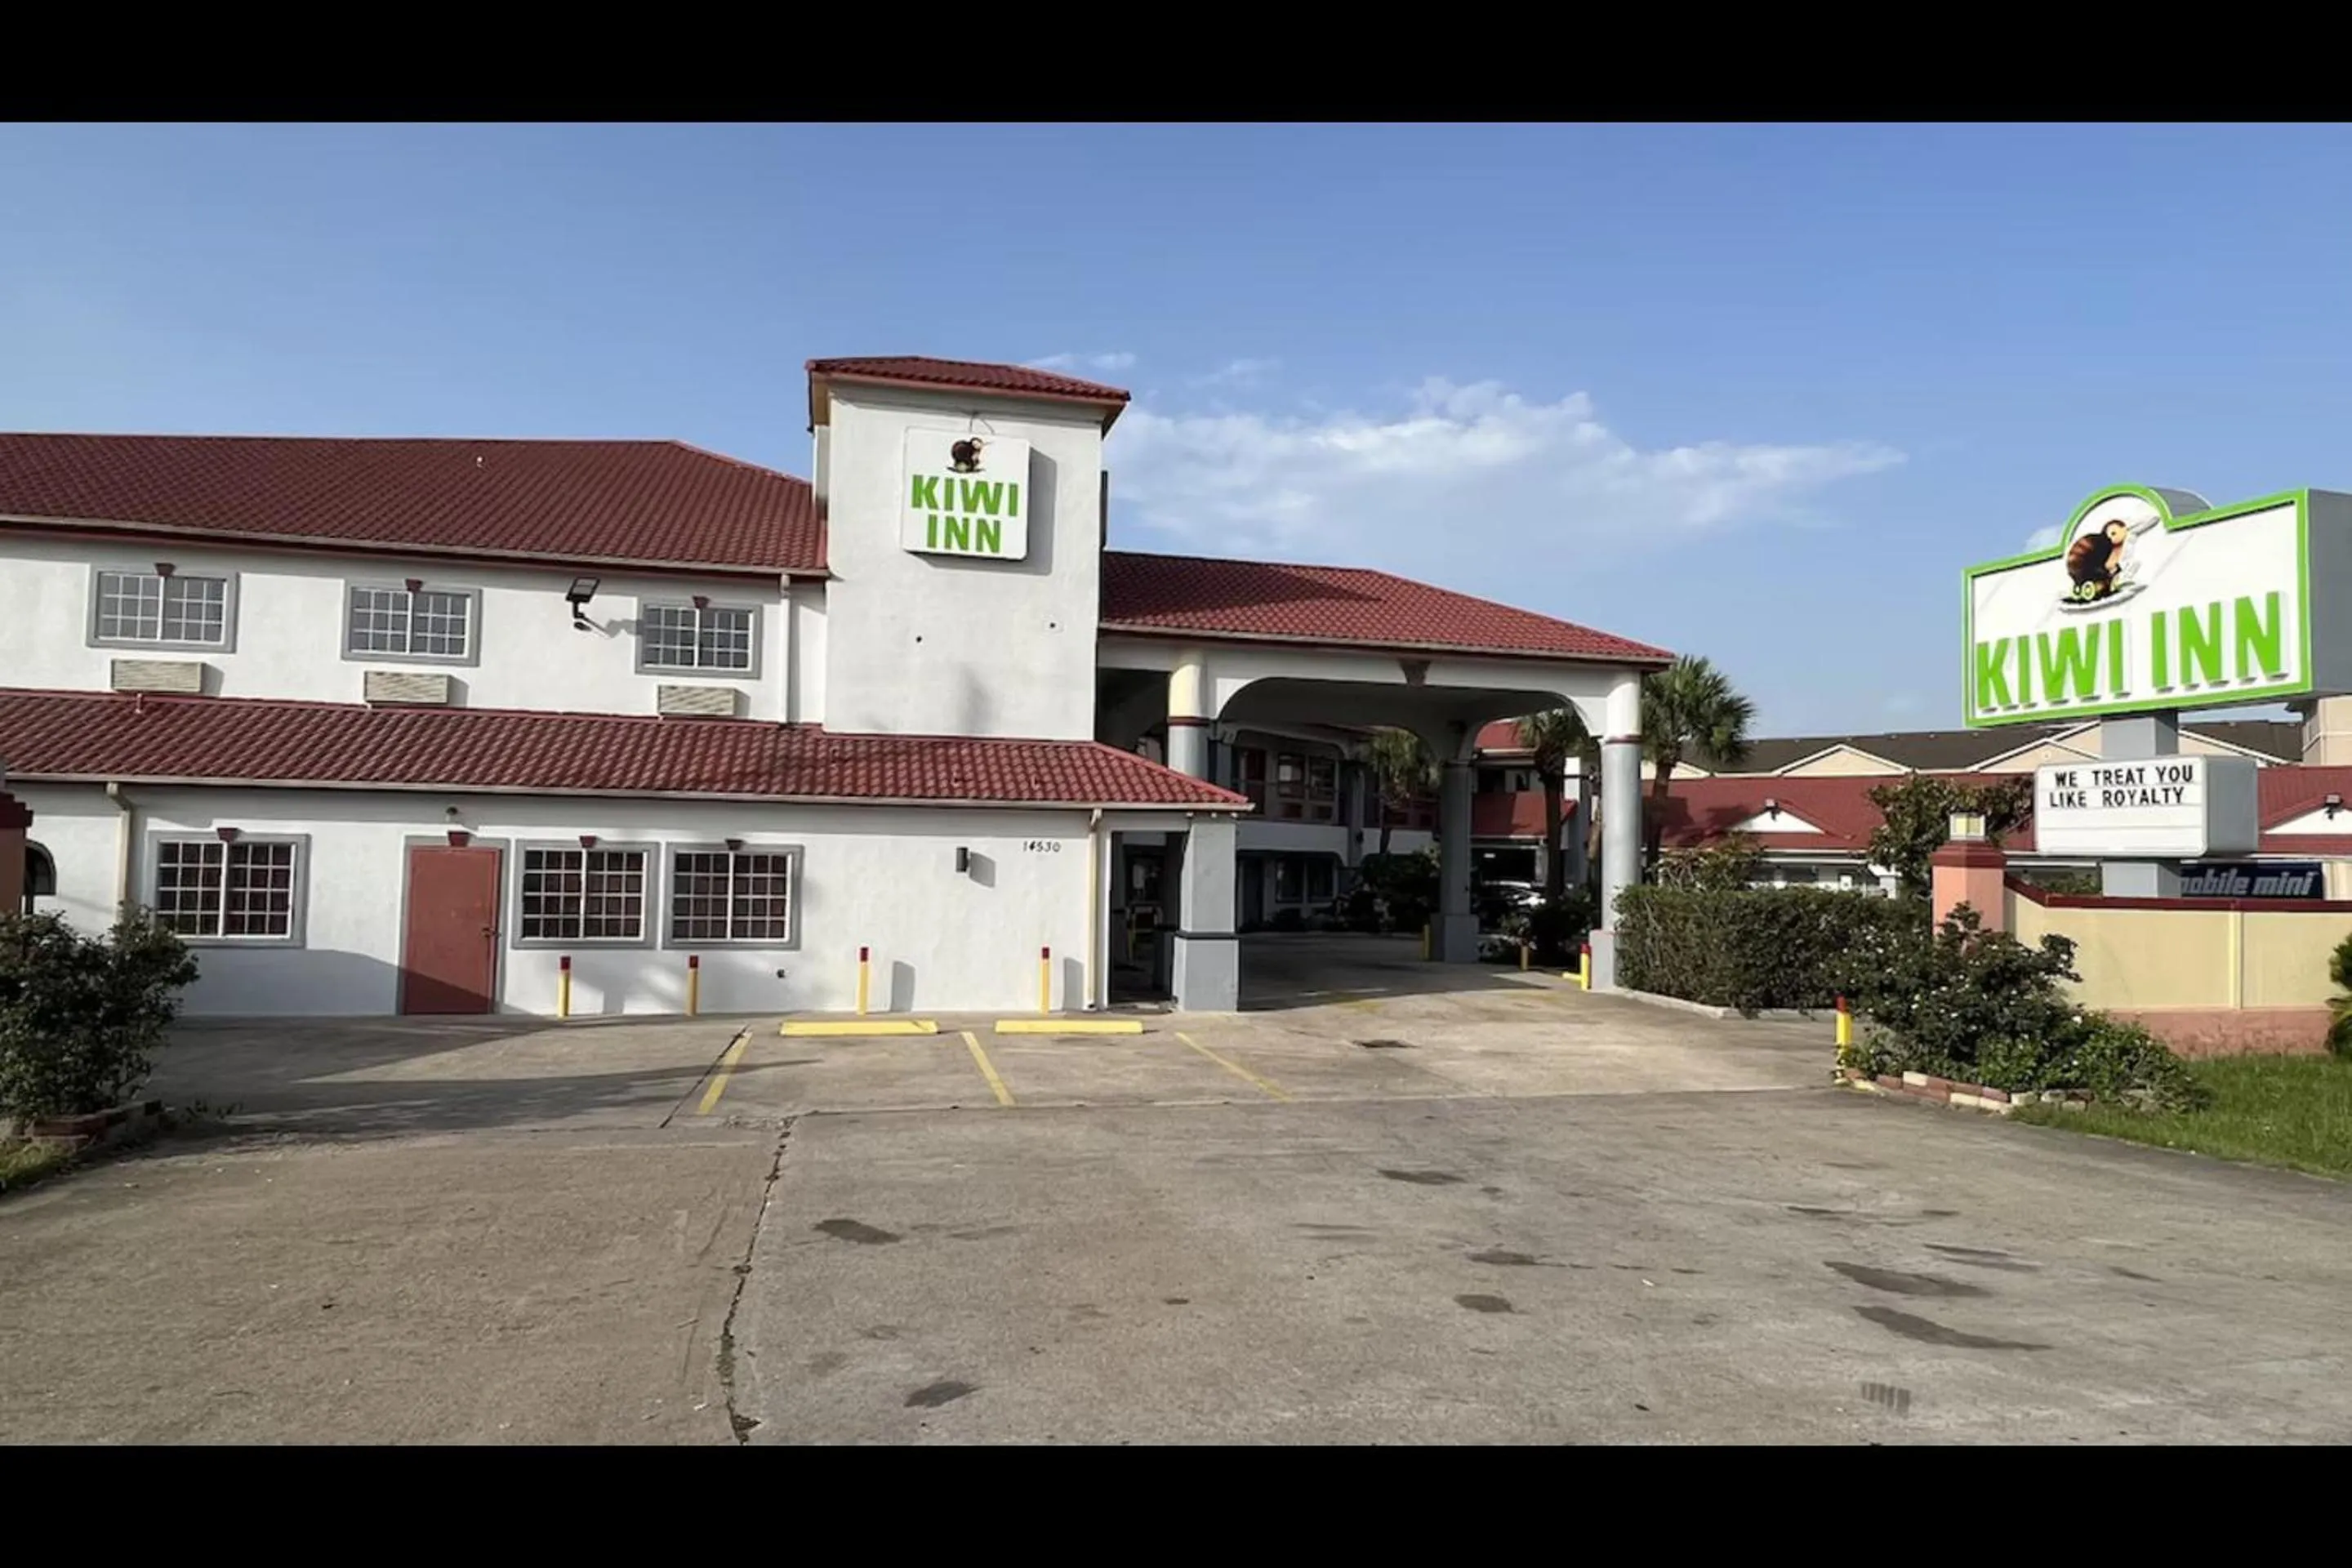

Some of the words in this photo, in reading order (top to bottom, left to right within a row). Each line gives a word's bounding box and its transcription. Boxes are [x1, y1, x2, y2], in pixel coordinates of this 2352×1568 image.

[911, 474, 1018, 517] KIWI
[927, 514, 1000, 553] INN
[1976, 618, 2125, 710] KIWI
[2151, 591, 2282, 693] INN
[2055, 771, 2078, 787] WE
[2092, 767, 2145, 786] TREAT
[2156, 764, 2194, 782] YOU
[2050, 791, 2087, 808] LIKE
[2102, 786, 2185, 807] ROYALTY
[1022, 840, 1062, 852] 14530
[2252, 871, 2316, 895] mini
